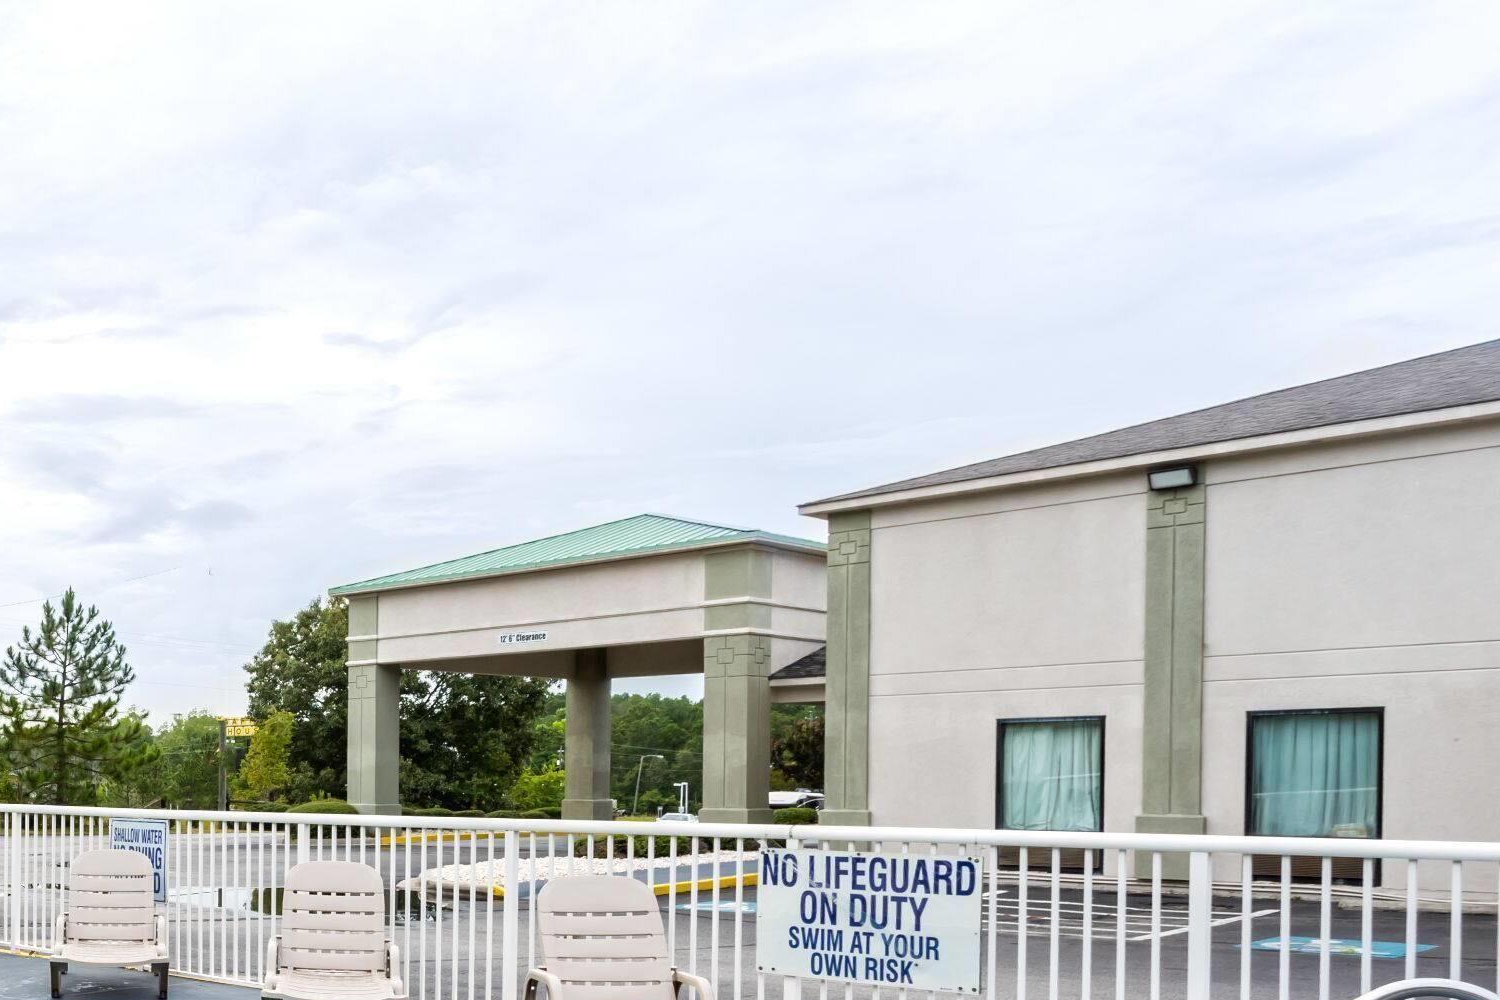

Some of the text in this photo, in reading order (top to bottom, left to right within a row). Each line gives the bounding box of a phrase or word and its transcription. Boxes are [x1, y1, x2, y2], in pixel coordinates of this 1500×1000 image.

[516, 633, 546, 641] Clearance
[113, 827, 163, 844] SHALLOW WATER
[762, 853, 976, 896] NO LIFEGUARD
[800, 890, 929, 932] ON DUTY
[788, 926, 940, 961] SWIM AT YOUR
[810, 952, 914, 985] OWN RISK
